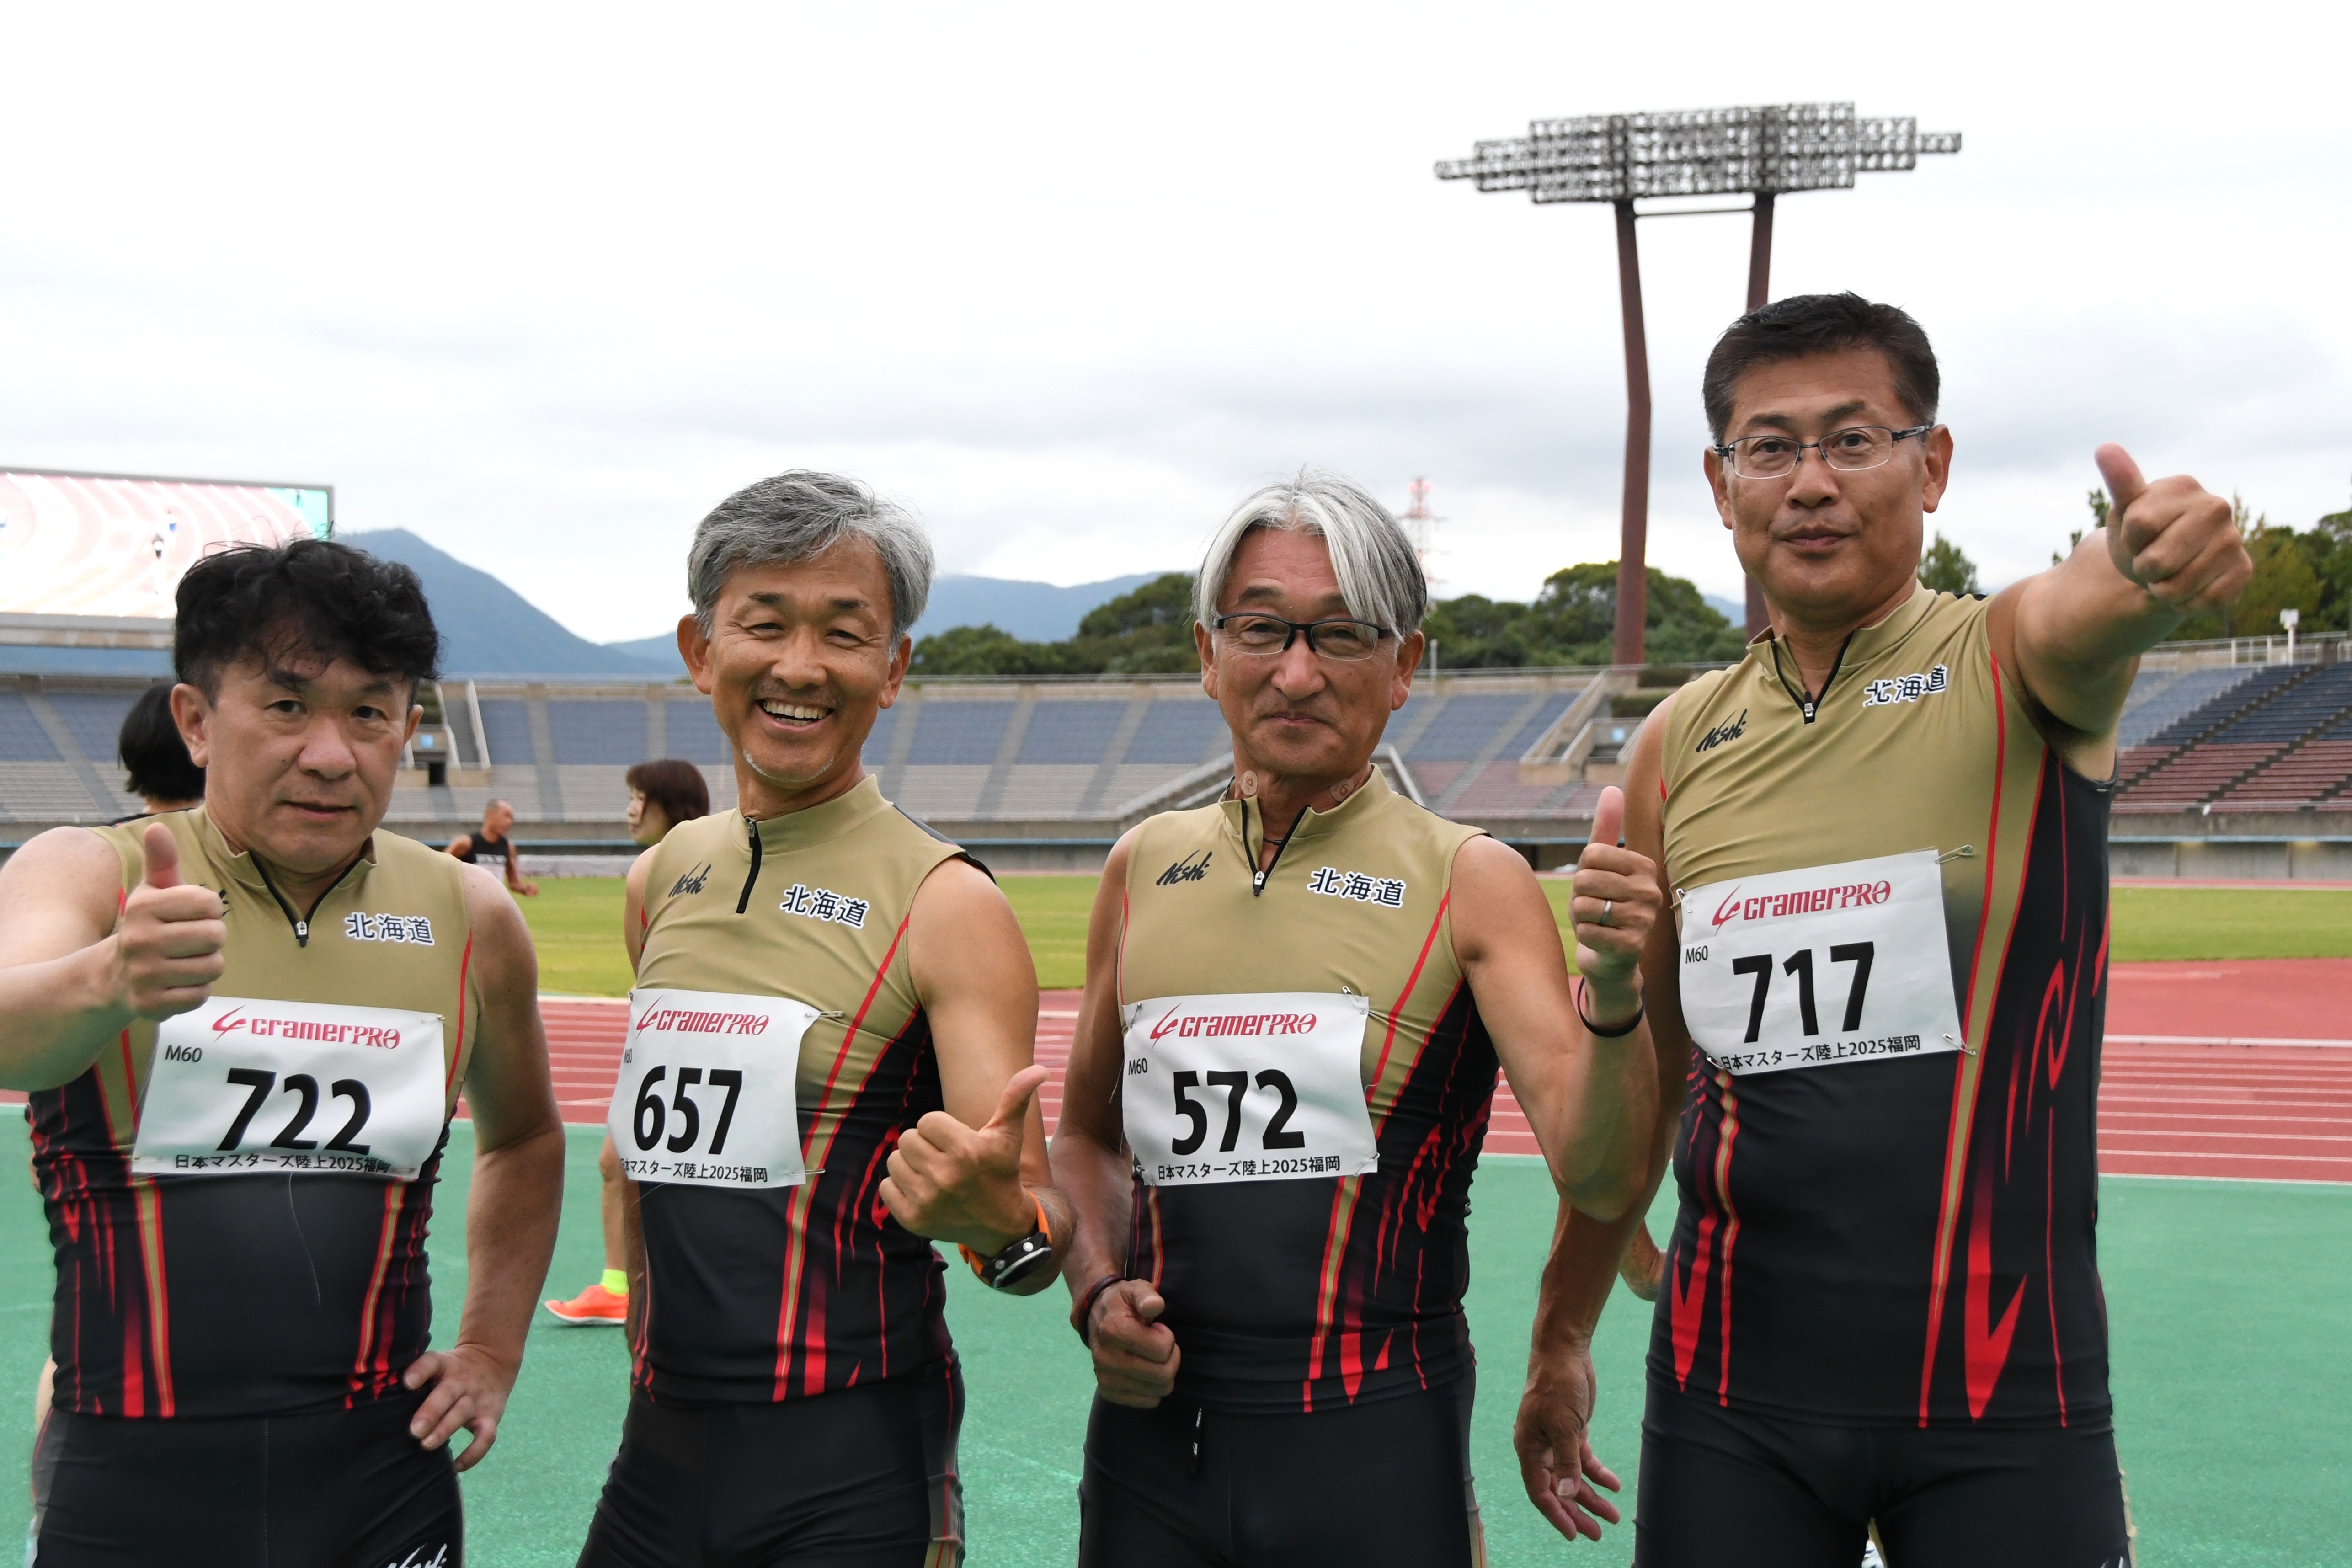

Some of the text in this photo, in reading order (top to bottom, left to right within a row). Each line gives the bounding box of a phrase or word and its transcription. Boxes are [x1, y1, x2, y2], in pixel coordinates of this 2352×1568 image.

[1865, 665, 1948, 706] 北海道
[781, 885, 868, 928] 北海道
[1309, 868, 1405, 907] 北海道
[346, 914, 433, 944] 北海道
[1685, 945, 1708, 964] M60
[1732, 941, 1875, 1044] 717
[165, 1045, 203, 1063] M60
[1128, 1057, 1148, 1076] M60
[1720, 1034, 1920, 1071] 日本マスターズ陸上2025福岡
[216, 1067, 372, 1156] 722
[634, 1065, 742, 1155] 657
[1171, 1069, 1306, 1156] 572
[175, 1154, 392, 1173] 日本マスターズ陸上2025福岡
[1158, 1155, 1341, 1181] 日本マスターズ陸上2025福岡
